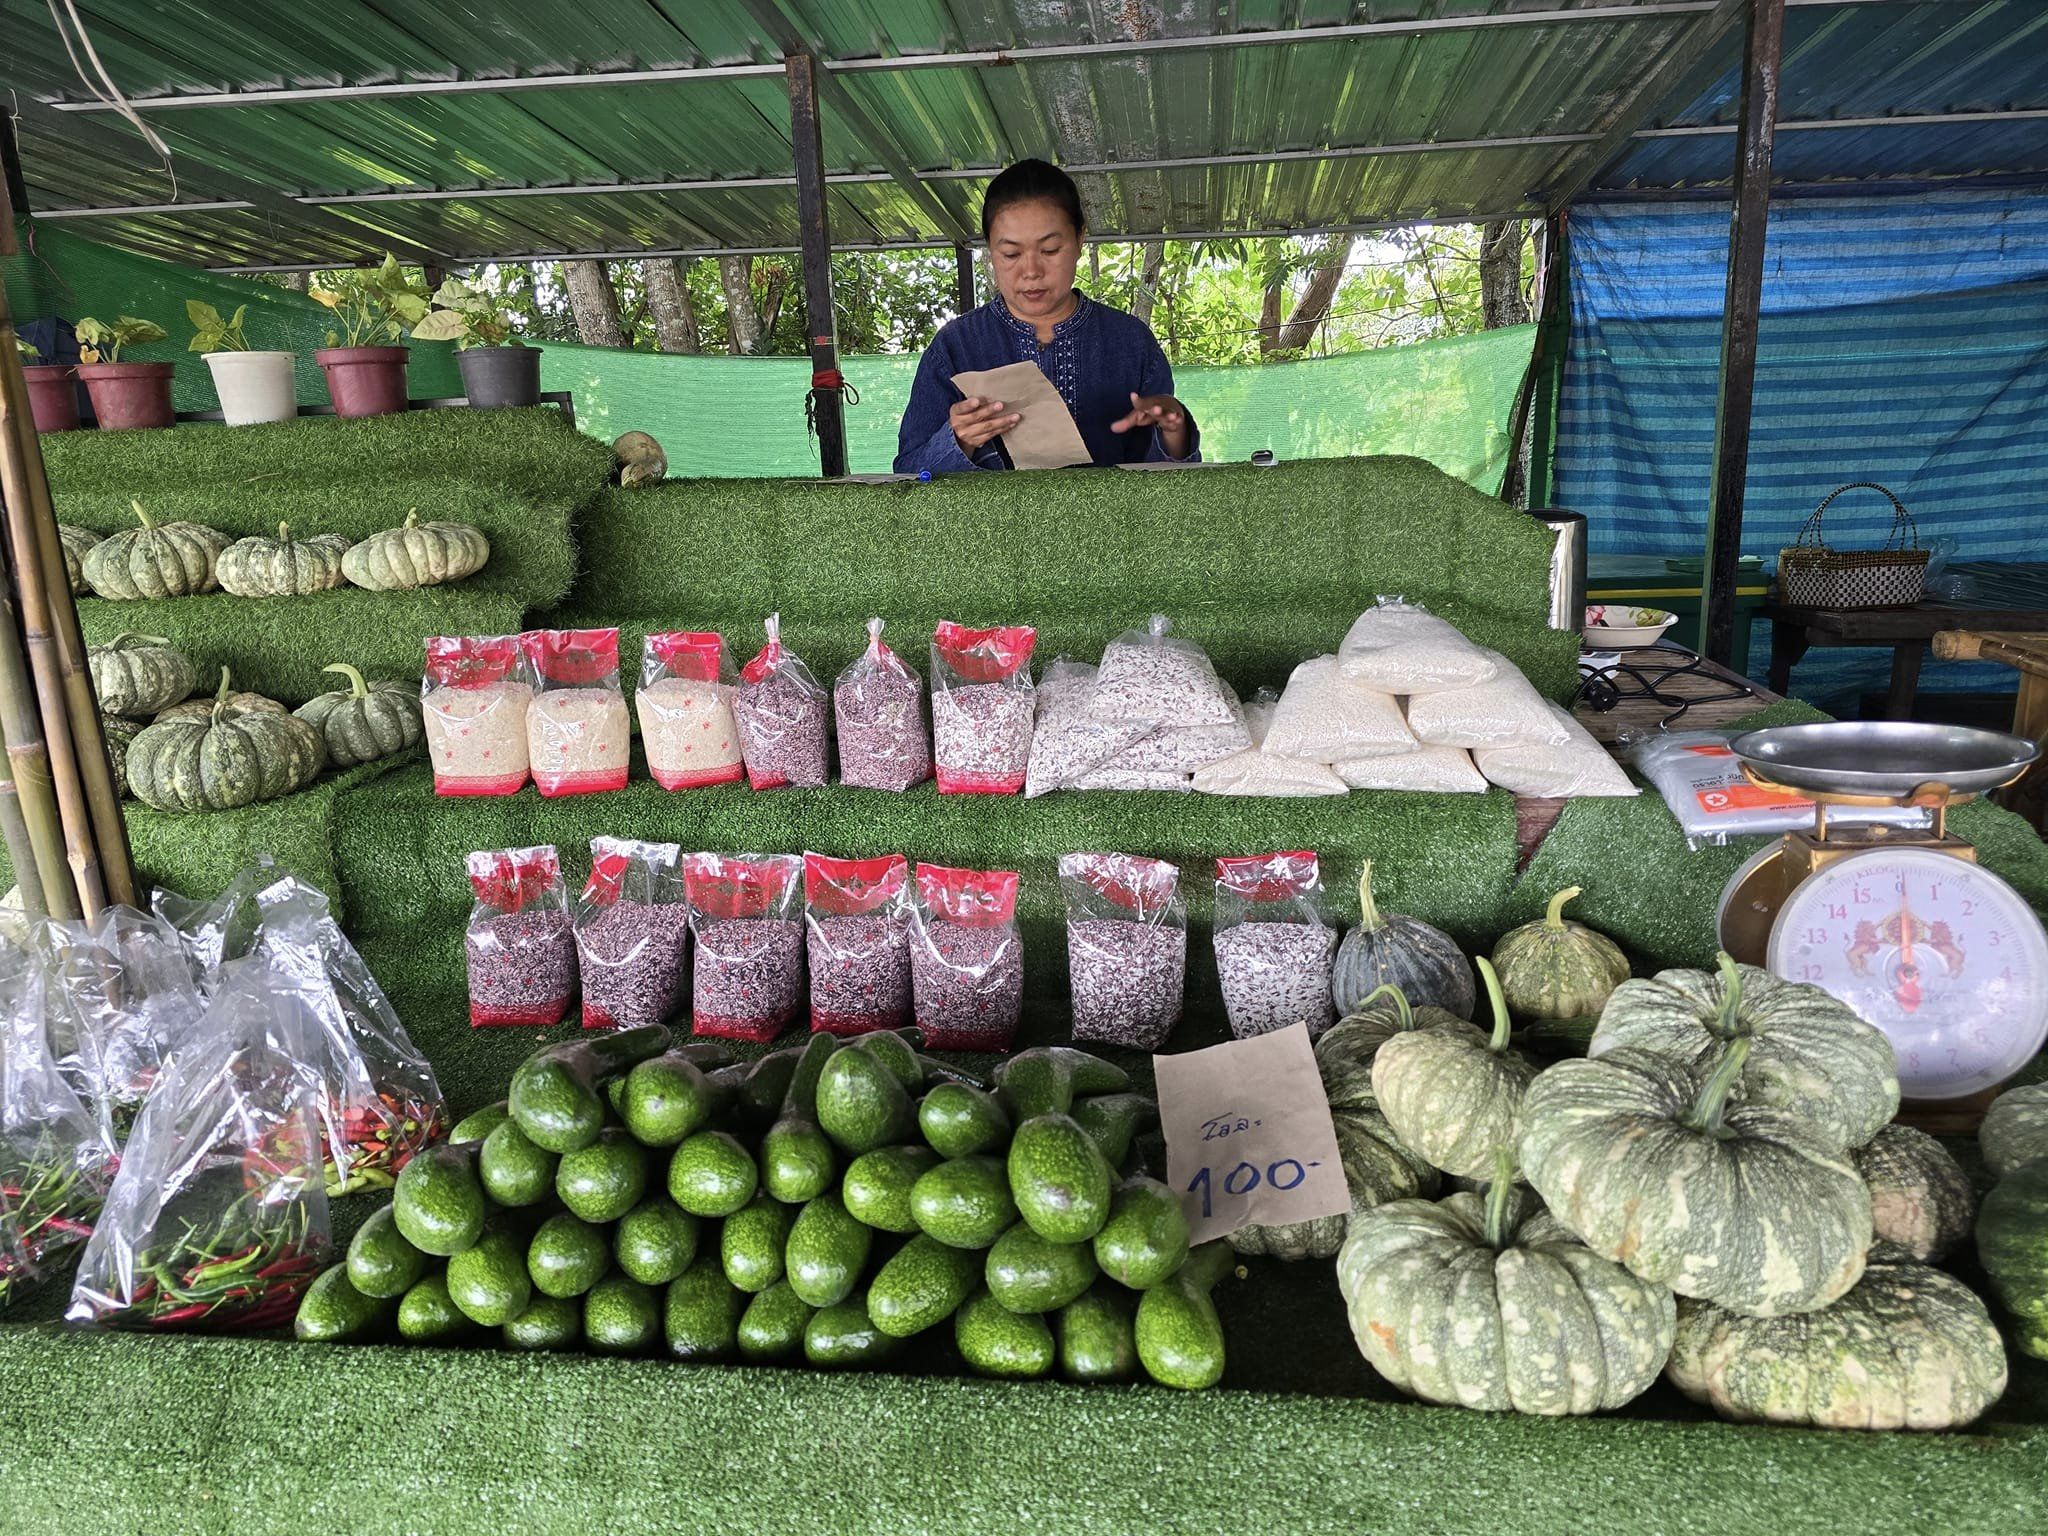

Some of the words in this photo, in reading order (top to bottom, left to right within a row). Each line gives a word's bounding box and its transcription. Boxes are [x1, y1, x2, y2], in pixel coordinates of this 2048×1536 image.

[1852, 887, 1871, 904] 15
[1930, 884, 1938, 900] 1
[1828, 904, 1848, 920] 14
[1961, 901, 1974, 916] 2
[1807, 928, 1828, 944] 13
[1989, 931, 2000, 946] 3
[1801, 965, 1824, 980] 12
[1908, 1051, 1921, 1069] 8
